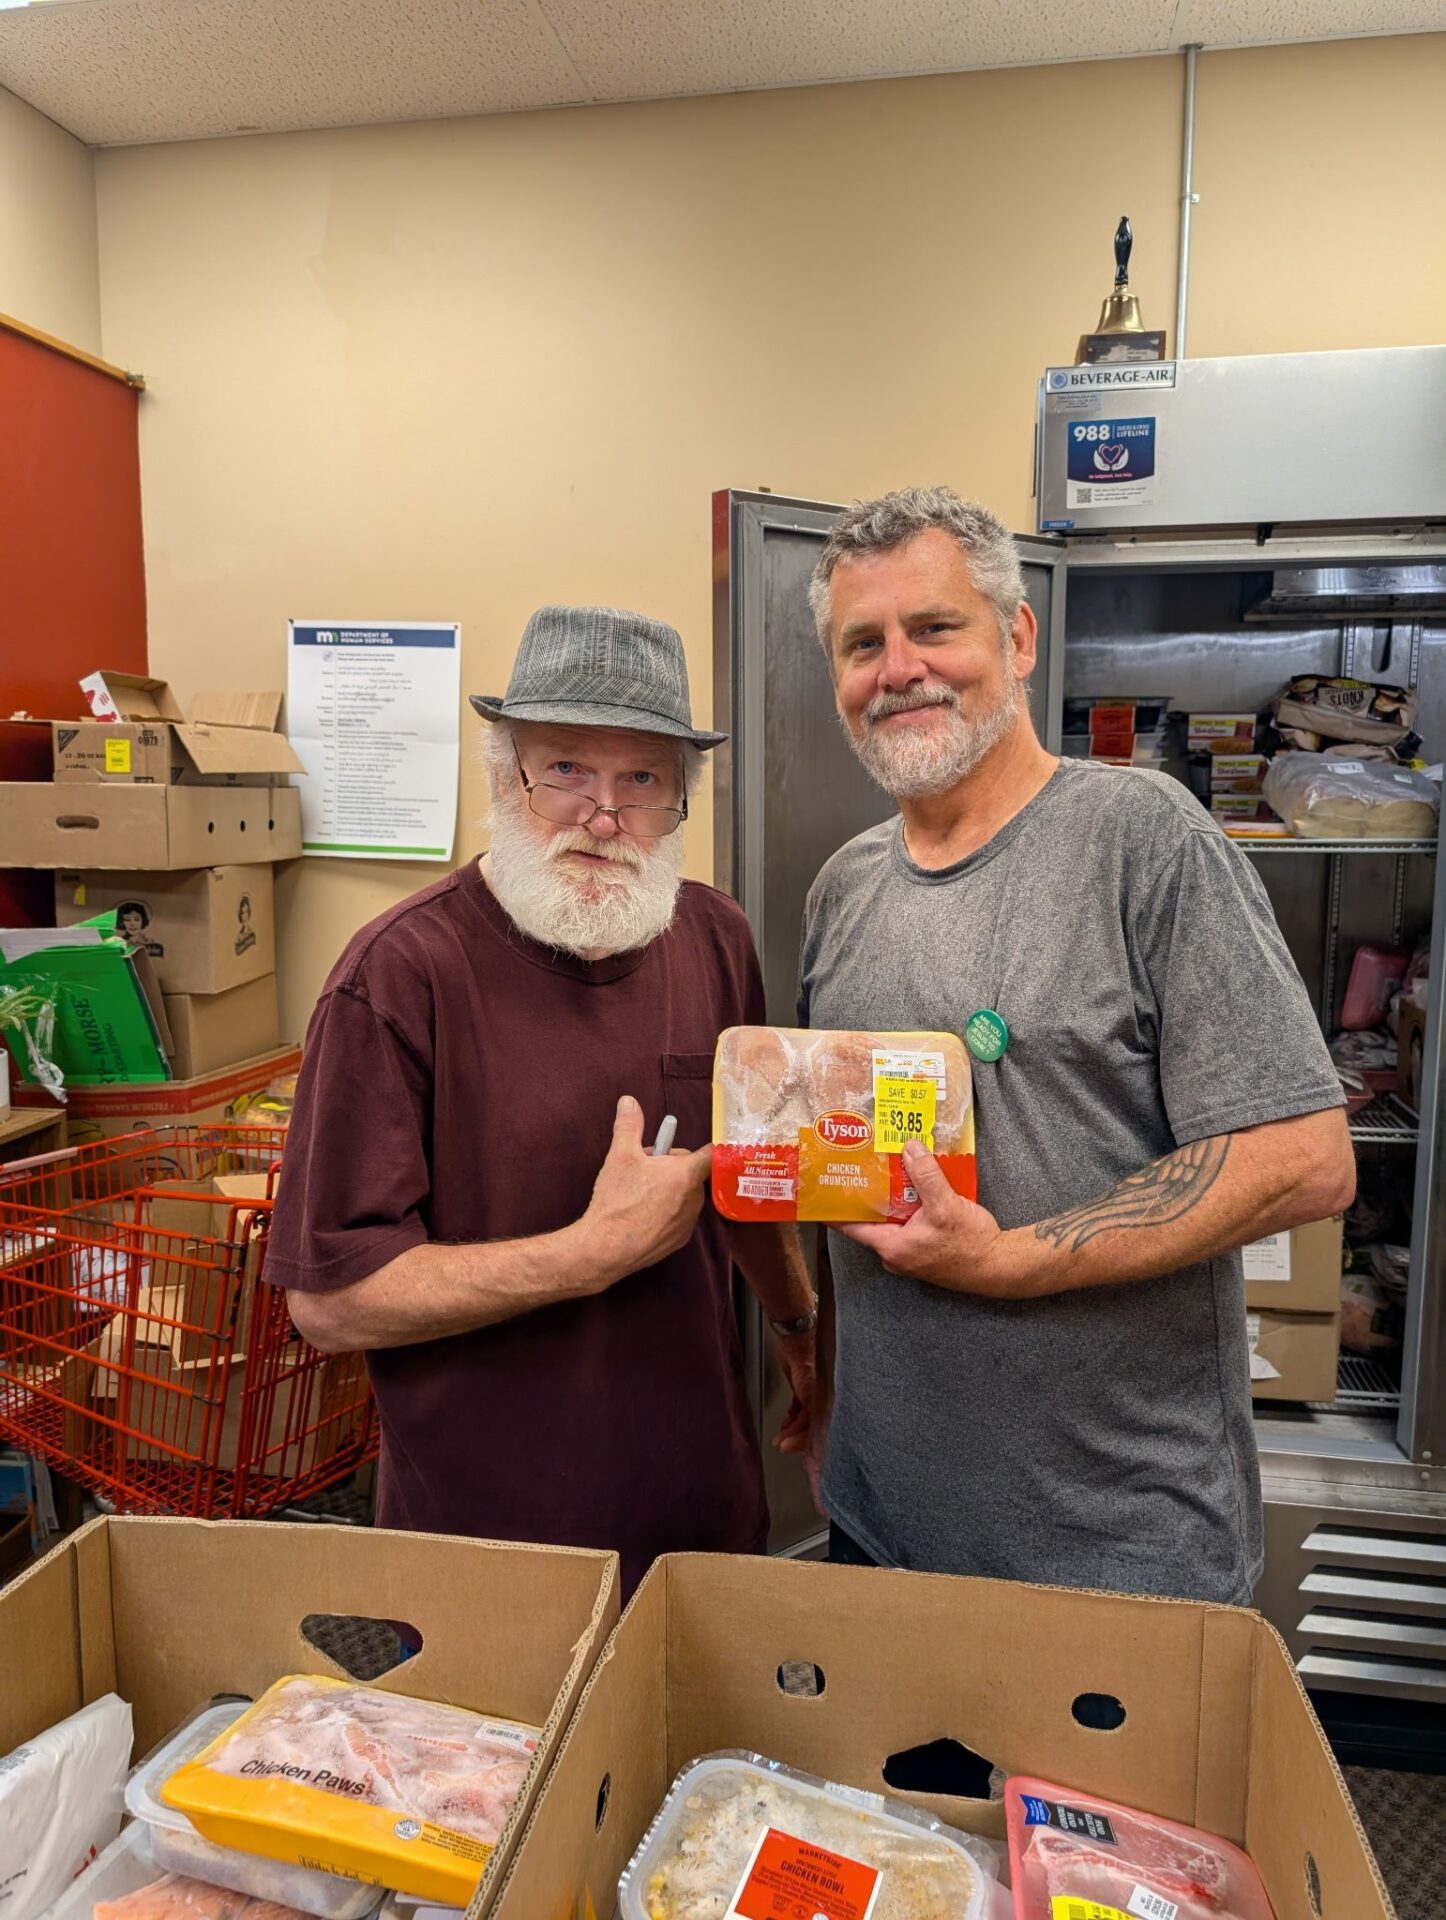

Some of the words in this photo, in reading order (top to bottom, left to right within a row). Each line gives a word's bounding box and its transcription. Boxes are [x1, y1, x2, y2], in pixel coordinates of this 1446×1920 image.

[1073, 424, 1110, 442] 988
[1116, 430, 1150, 438] LIFELINE
[1329, 690, 1364, 706] KNOTS
[973, 1018, 990, 1036] READY
[990, 1034, 1002, 1047] FOR
[979, 1014, 990, 1026] ARE
[990, 1023, 1002, 1037] YOU
[988, 1041, 996, 1050] TO
[888, 1087, 906, 1098] SAVE
[910, 1088, 926, 1100] $0.57
[821, 1118, 869, 1141] Tyson
[890, 1109, 922, 1133] $3.85
[754, 1151, 776, 1160] Fresh
[744, 1166, 754, 1174] All
[755, 1166, 787, 1176] Natural
[826, 1162, 860, 1174] CHICKEN
[819, 1174, 869, 1188] DRUMSTICKS
[240, 1760, 311, 1780] Chicken
[313, 1770, 365, 1795] Paws
[798, 1848, 842, 1870] MARKETSIDE
[780, 1860, 818, 1884] CHICKEN
[820, 1876, 844, 1895] BOWL
